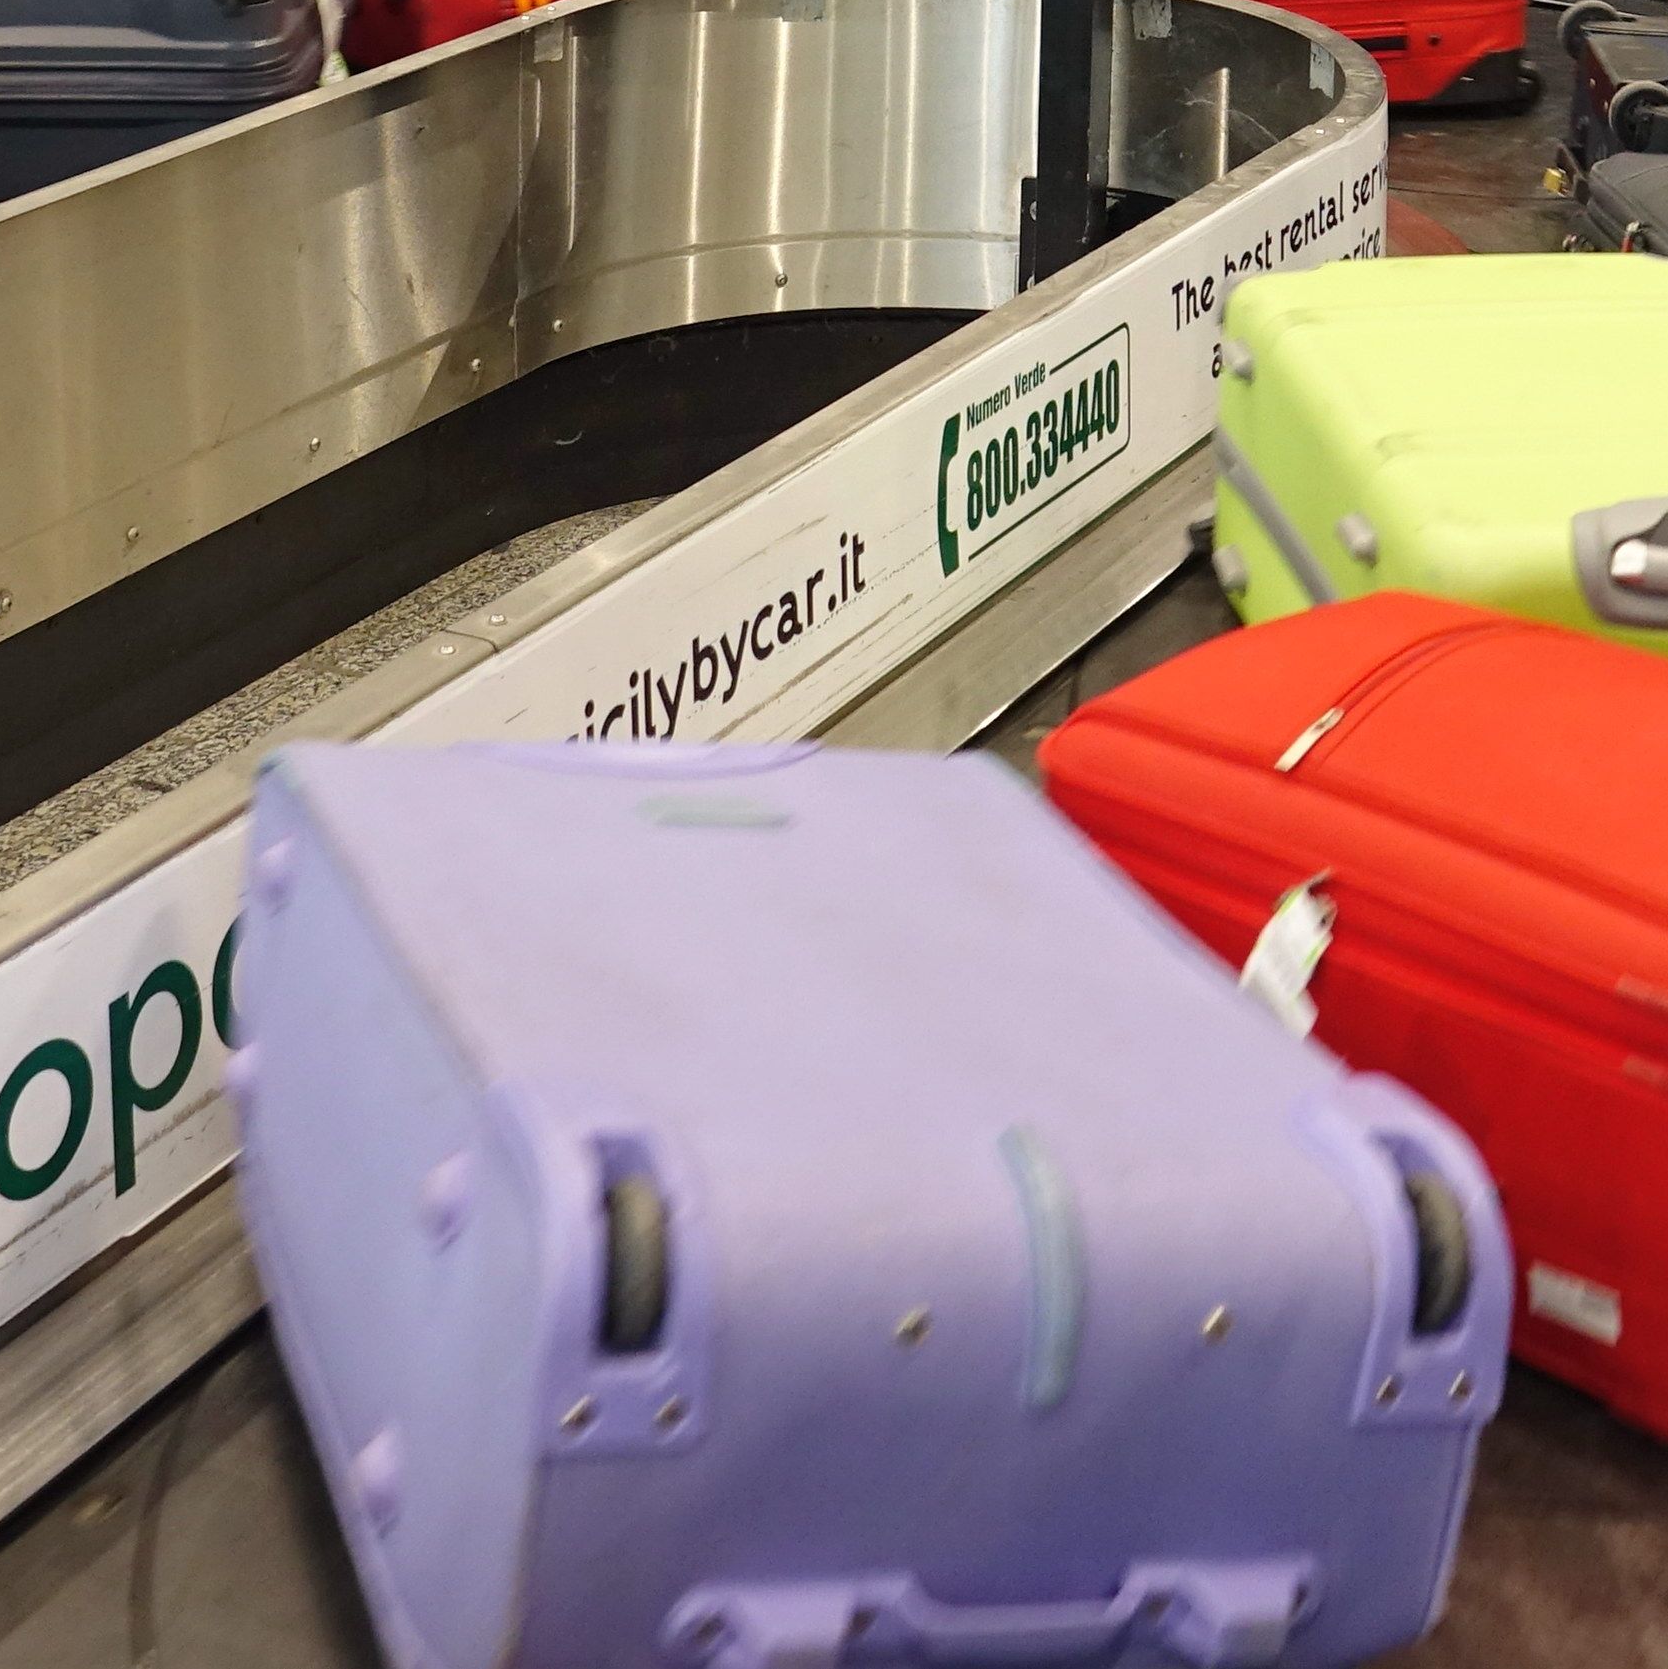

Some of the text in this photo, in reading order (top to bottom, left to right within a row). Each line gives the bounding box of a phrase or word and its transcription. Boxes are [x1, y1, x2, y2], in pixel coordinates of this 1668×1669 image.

[1172, 275, 1215, 332] The
[1280, 180, 1344, 263] rental
[967, 362, 1046, 431] Numero Verde
[967, 359, 1120, 531] 800.334440
[565, 531, 866, 745] icilybycar.it
